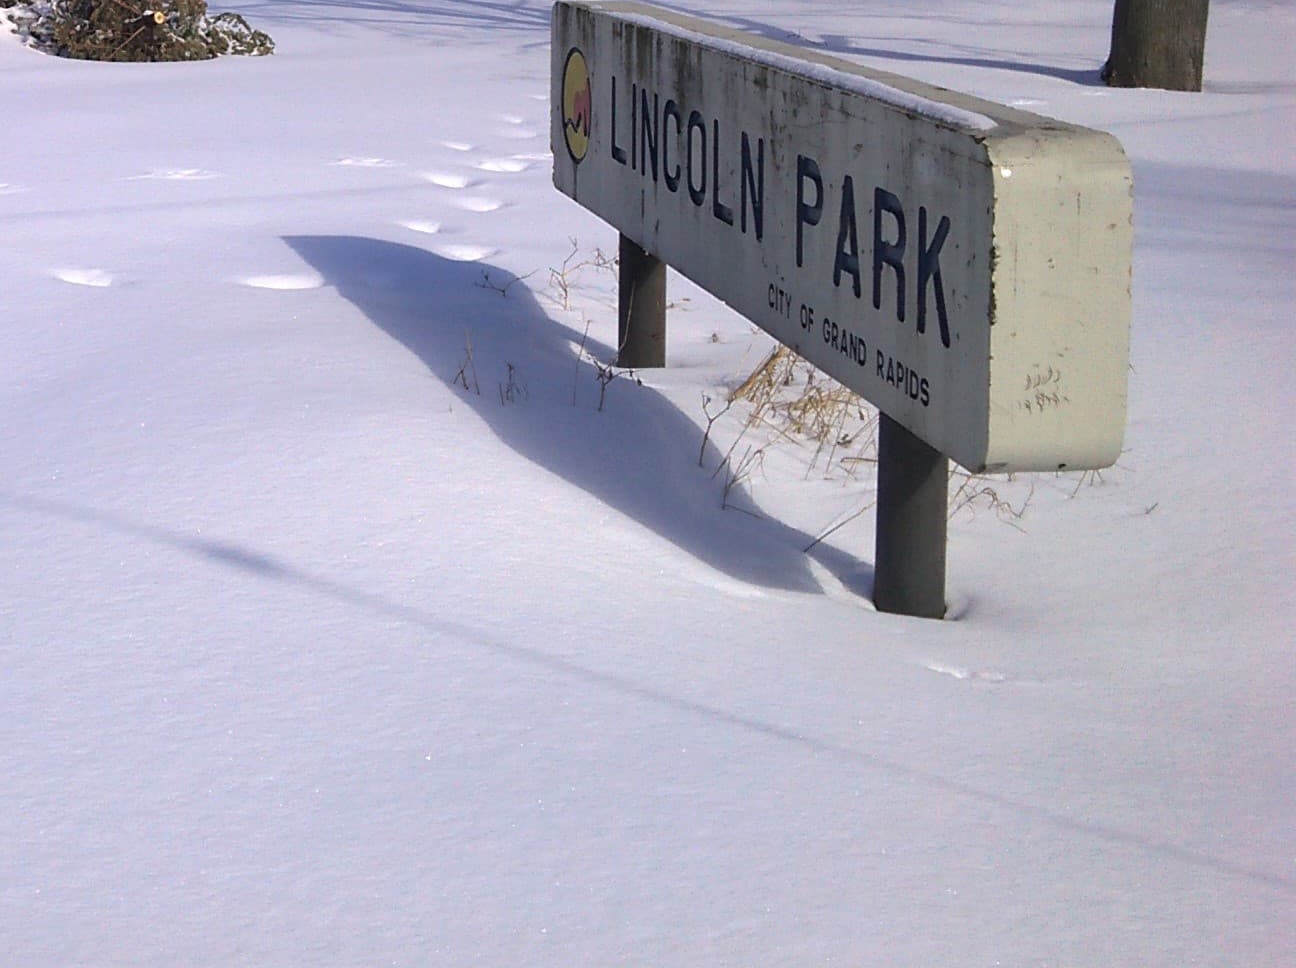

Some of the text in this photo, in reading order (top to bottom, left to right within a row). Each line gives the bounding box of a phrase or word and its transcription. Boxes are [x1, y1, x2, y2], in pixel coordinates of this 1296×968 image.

[611, 76, 951, 348] LINCOLN PARK
[768, 283, 930, 407] CITY OF GRAND RAPIDS
